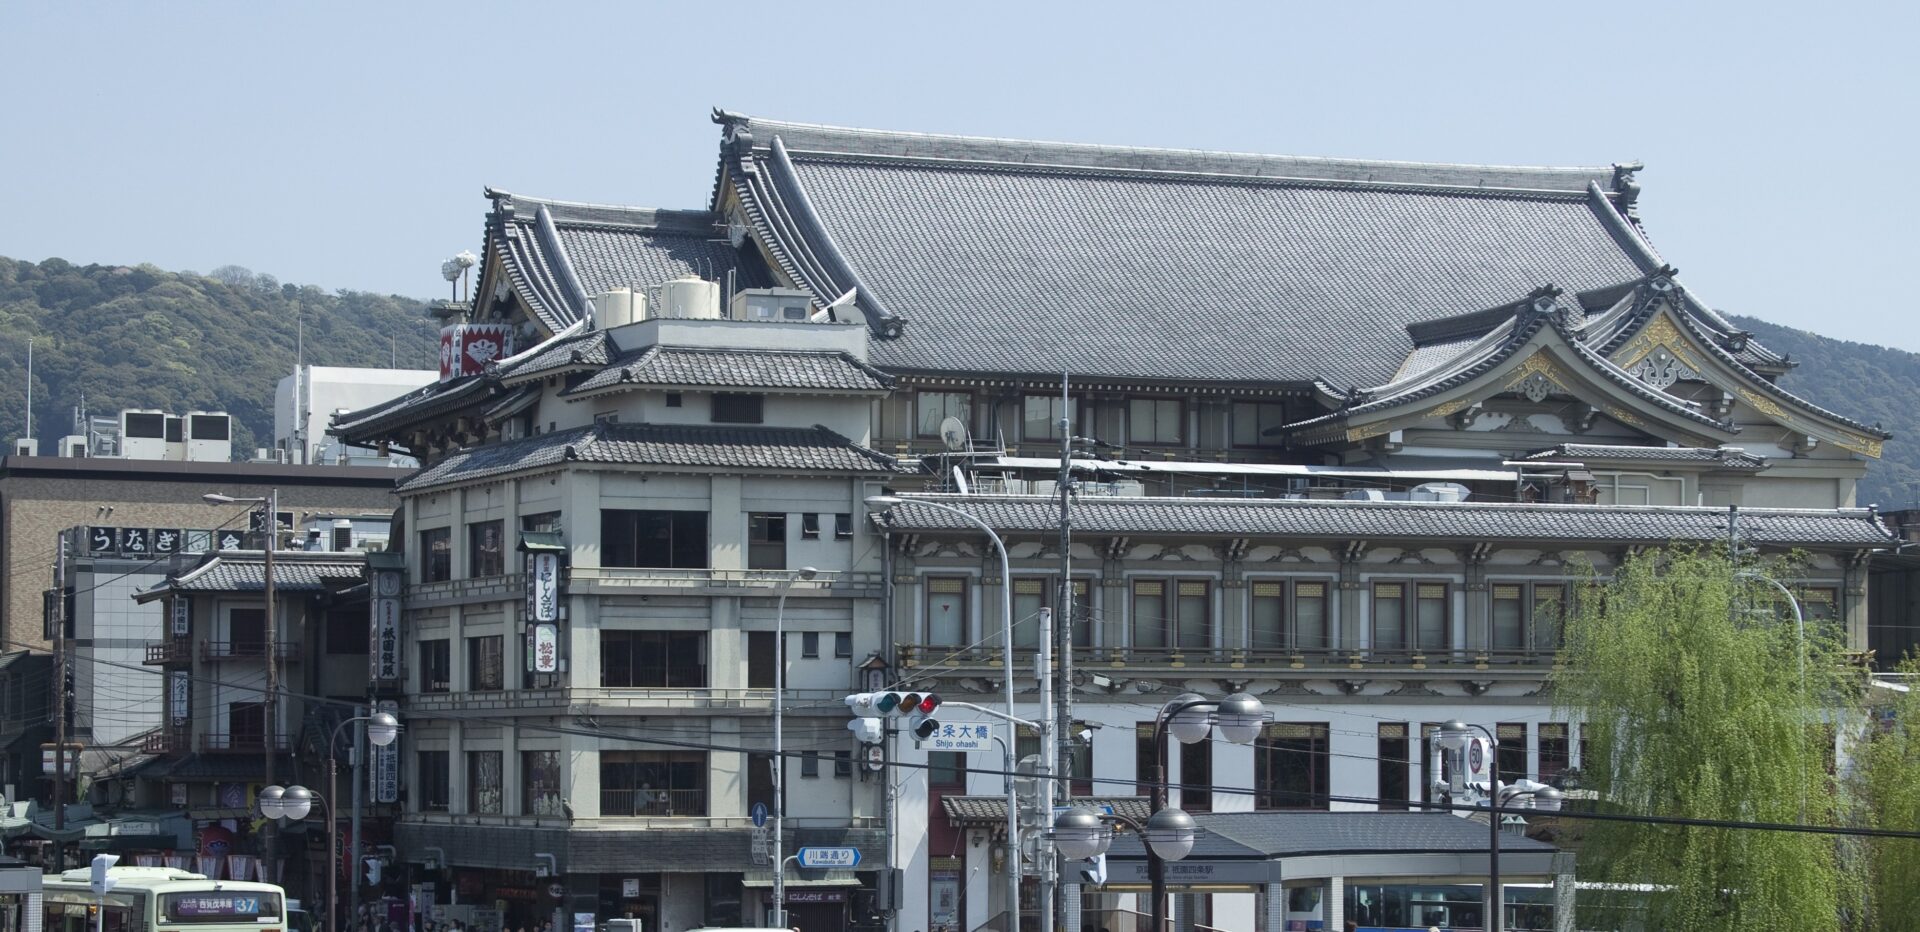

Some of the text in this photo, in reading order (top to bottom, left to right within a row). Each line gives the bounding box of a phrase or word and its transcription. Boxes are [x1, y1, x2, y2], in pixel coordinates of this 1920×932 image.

[94, 528, 178, 551] うなぎ
[540, 572, 554, 618] にしんそば
[538, 641, 554, 669] 松葉
[935, 739, 979, 749] Shijo ohashi
[1471, 748, 1480, 764] 50
[808, 850, 850, 860] 川端通り
[236, 898, 256, 912] 37
